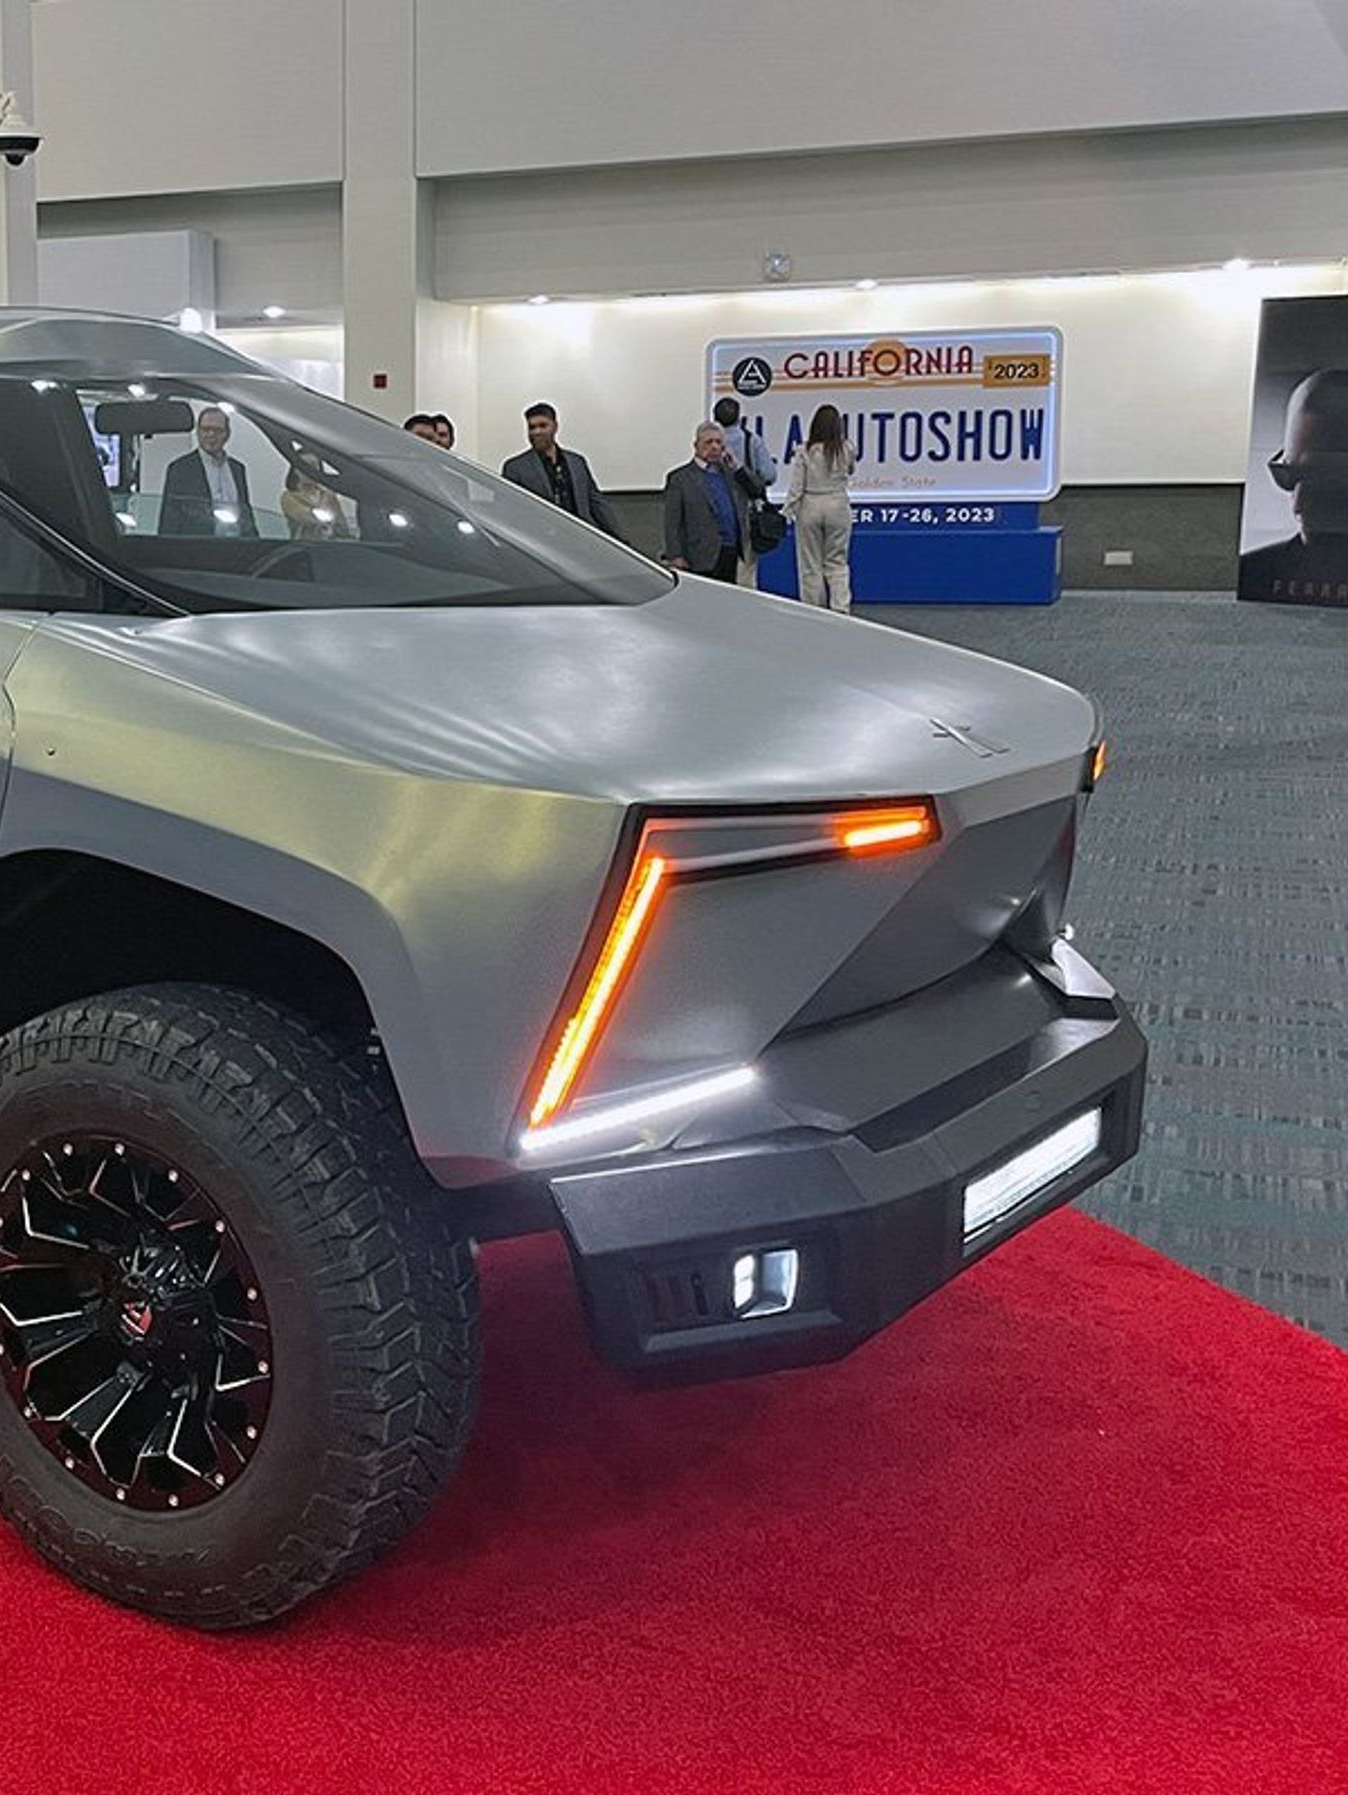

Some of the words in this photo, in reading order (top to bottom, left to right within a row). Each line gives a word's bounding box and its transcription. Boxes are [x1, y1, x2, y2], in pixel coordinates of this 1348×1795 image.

[784, 346, 973, 379] CALIFORNIA
[994, 362, 1039, 379] 2023
[841, 408, 1045, 464] UTOSHOW
[946, 507, 994, 523] 2023
